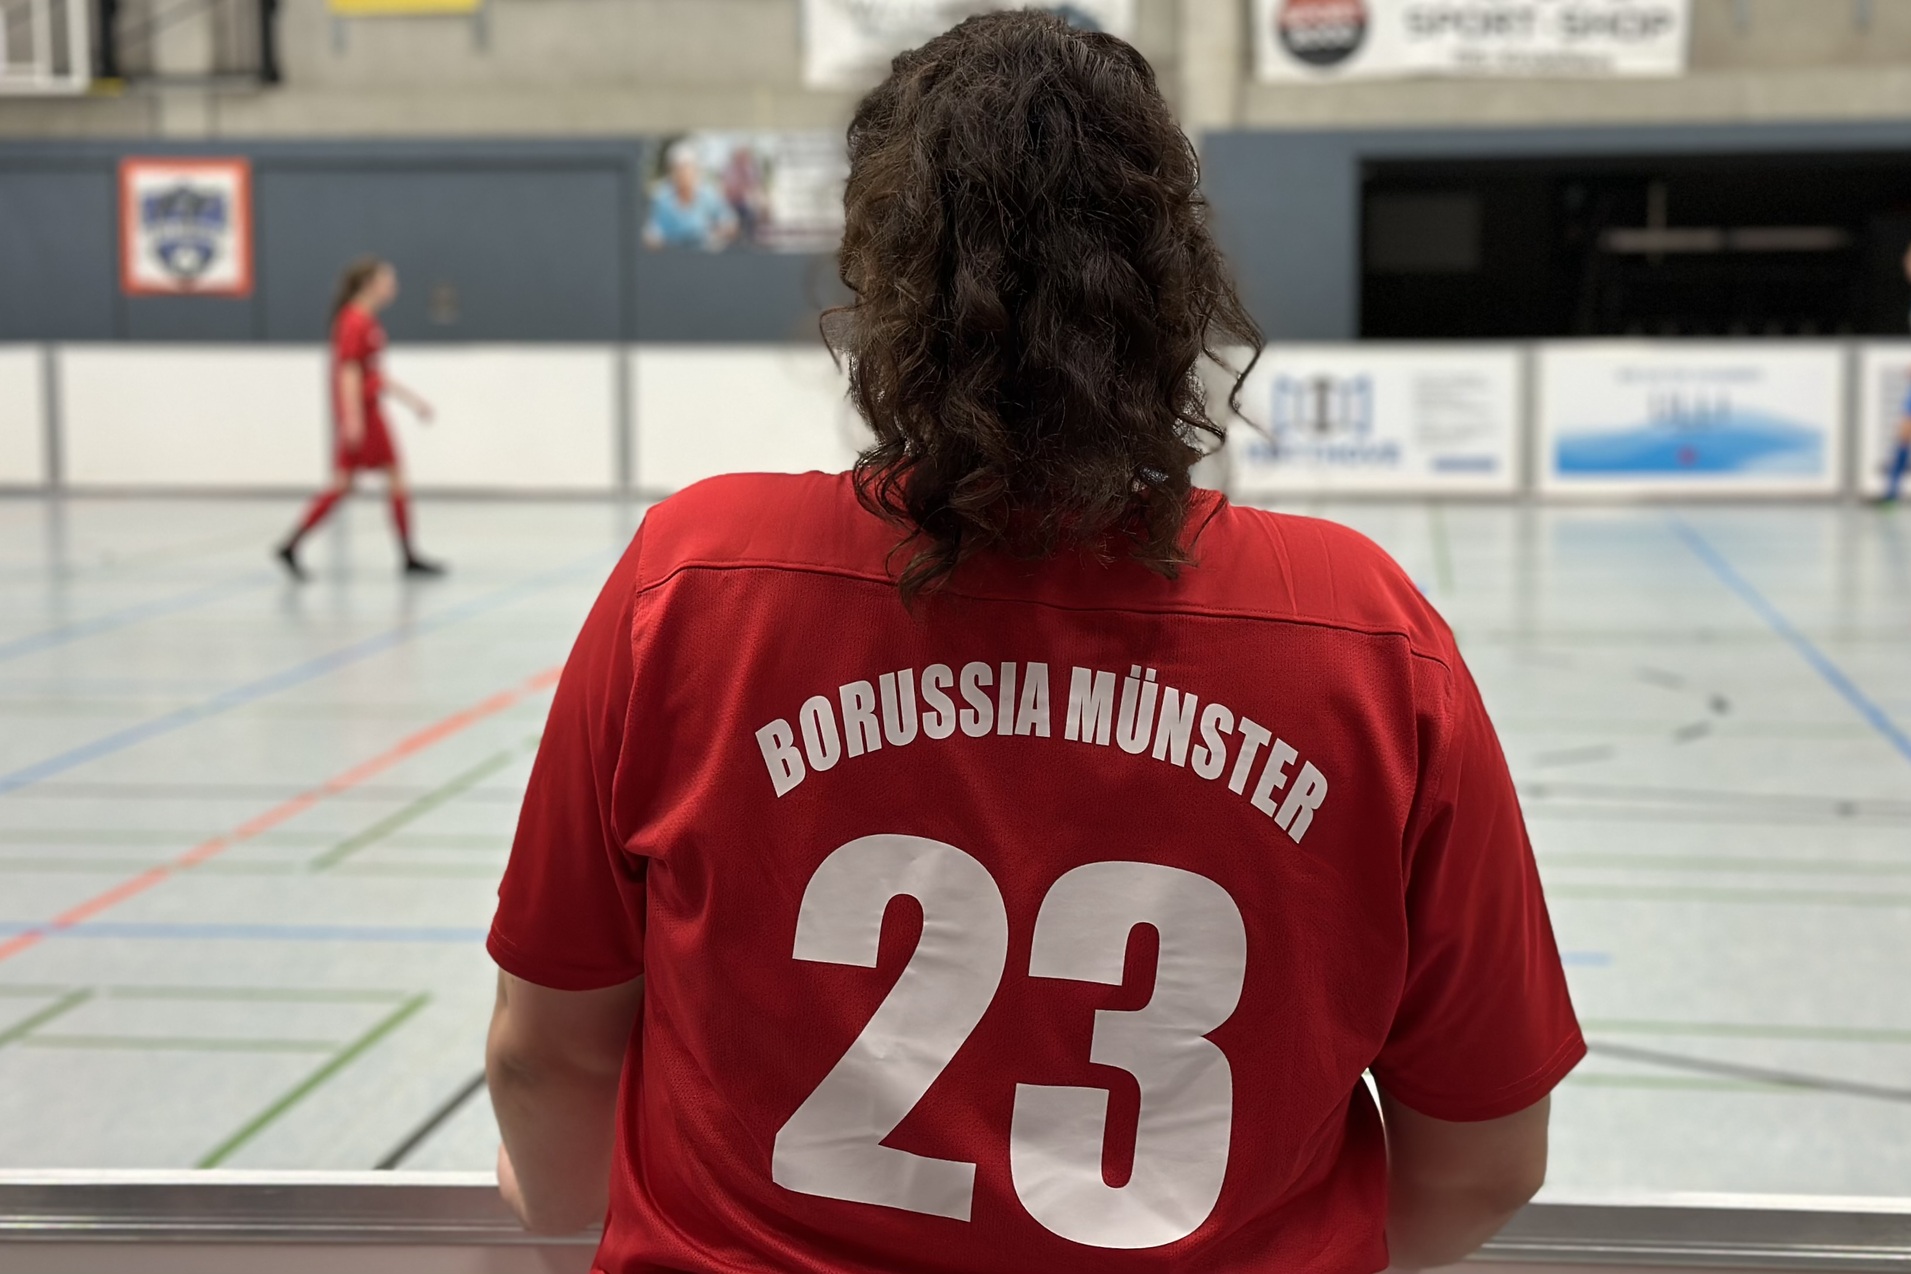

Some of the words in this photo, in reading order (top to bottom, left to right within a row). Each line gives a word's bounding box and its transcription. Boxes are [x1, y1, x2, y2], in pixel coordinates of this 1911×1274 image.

[755, 661, 1051, 798] BORUSSIA
[1064, 664, 1328, 844] MÜNSTER
[771, 833, 1248, 1250] 23
